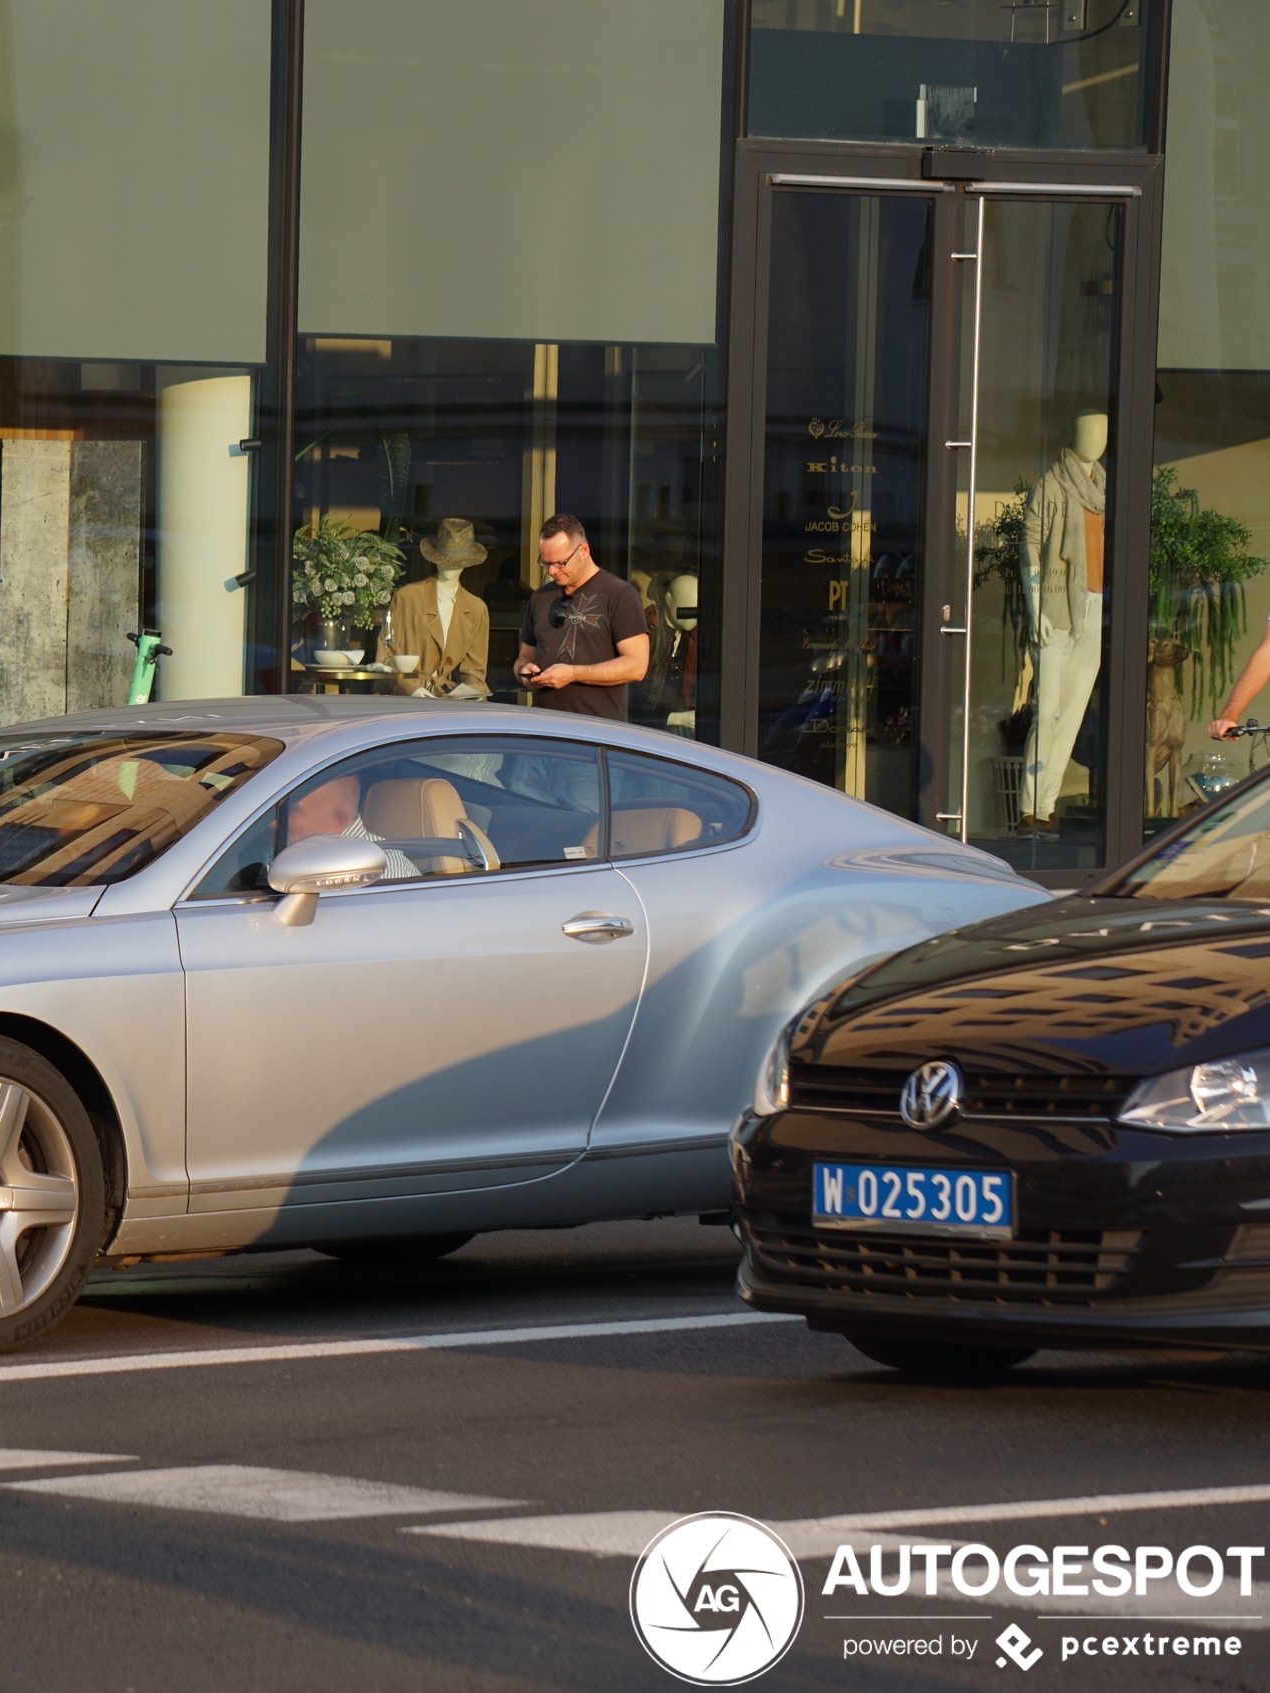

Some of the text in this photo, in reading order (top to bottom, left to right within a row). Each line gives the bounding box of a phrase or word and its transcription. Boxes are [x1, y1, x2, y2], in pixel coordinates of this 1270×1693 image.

[807, 455, 877, 473] Kiton
[805, 521, 839, 532] JACOB
[829, 580, 849, 611] PT
[822, 1167, 1004, 1224] W 025305
